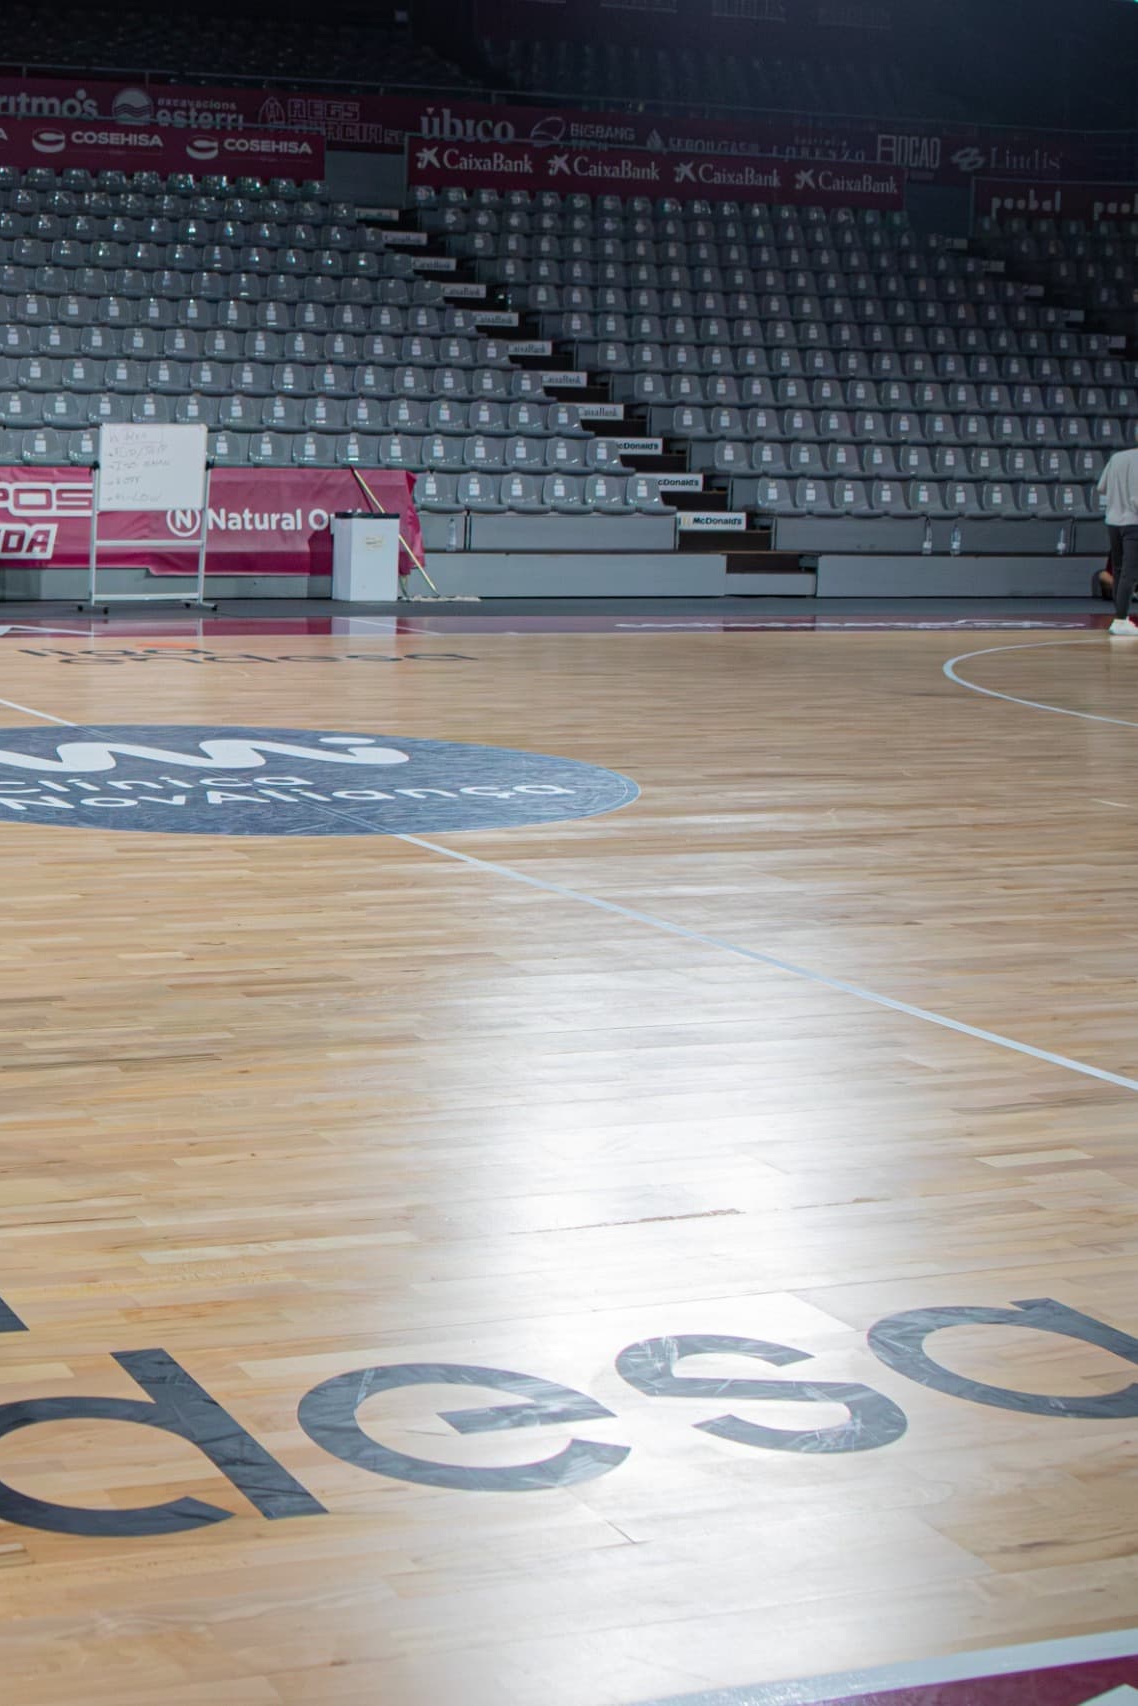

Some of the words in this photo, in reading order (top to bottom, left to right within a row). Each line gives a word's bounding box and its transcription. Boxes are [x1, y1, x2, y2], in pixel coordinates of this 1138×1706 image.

[71, 130, 164, 147] COSEHISA
[223, 137, 312, 154] COSEHISA
[443, 149, 534, 174] CaixaBank
[574, 156, 660, 181] CaixaBank
[698, 164, 782, 188] CaixaBank
[818, 171, 898, 194] CaixaBank
[208, 508, 302, 531] Natural
